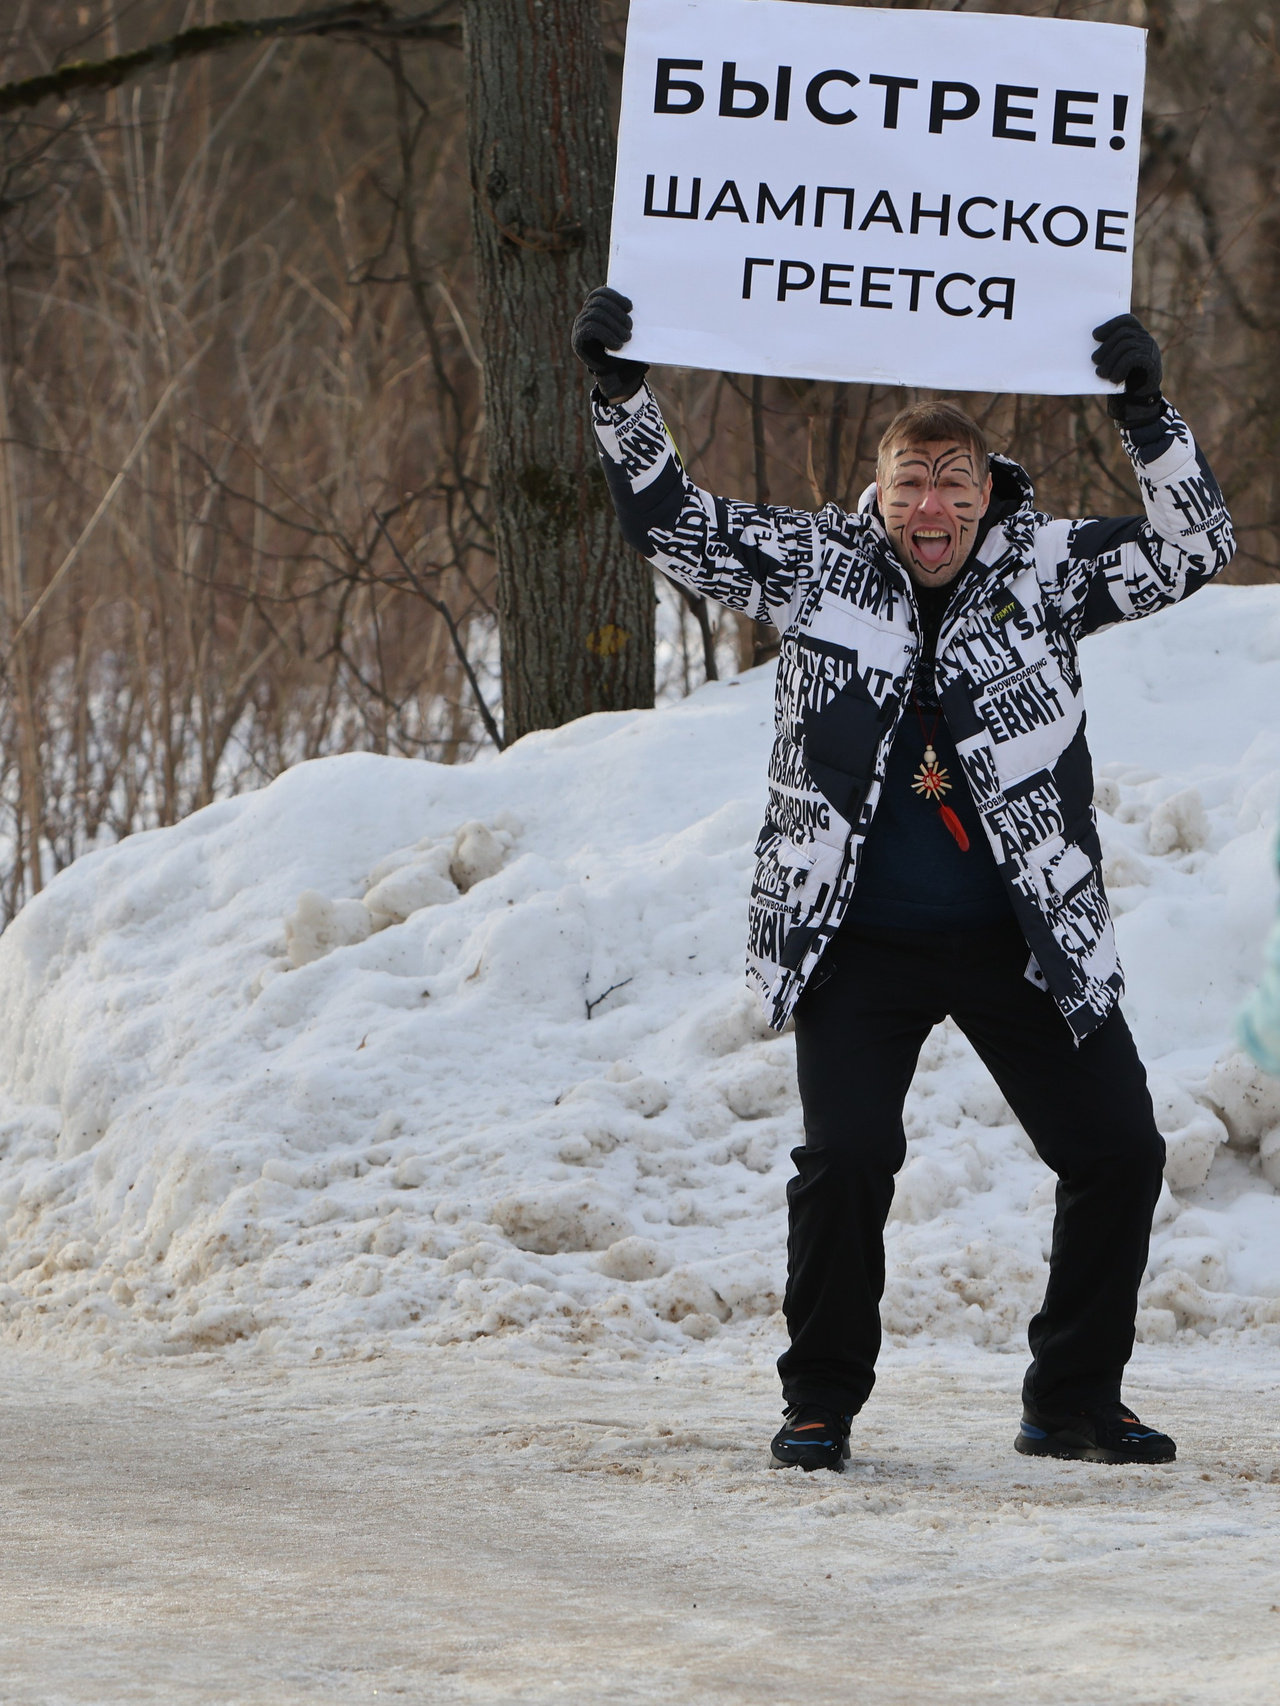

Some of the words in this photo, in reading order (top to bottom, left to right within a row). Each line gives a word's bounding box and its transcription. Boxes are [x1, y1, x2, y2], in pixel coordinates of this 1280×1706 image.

[654, 58, 1129, 151] БЫСТРЕЕ!
[644, 175, 1129, 253] ШАМПАНСКОЕ
[742, 257, 1016, 321] ГРЕЕТСЯ
[986, 657, 1048, 697] SNOWBOARDING
